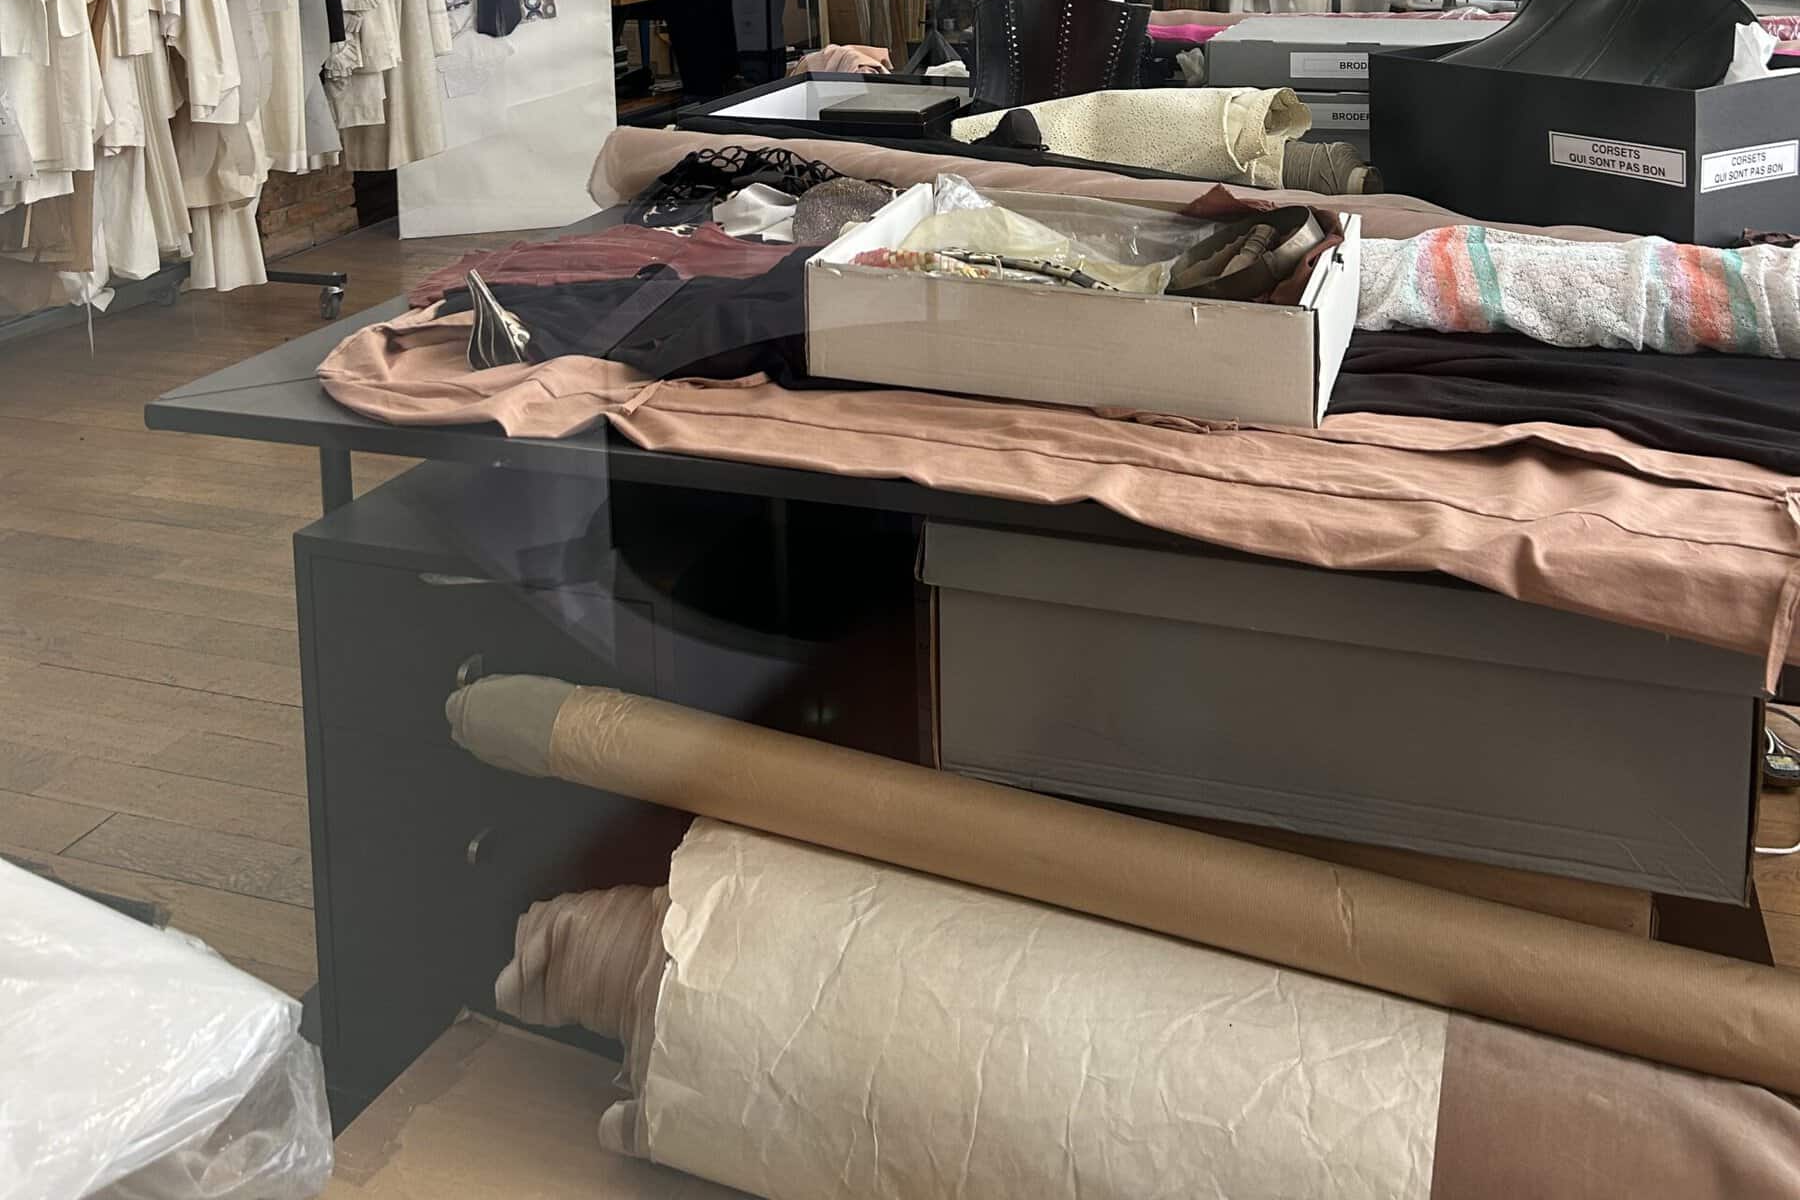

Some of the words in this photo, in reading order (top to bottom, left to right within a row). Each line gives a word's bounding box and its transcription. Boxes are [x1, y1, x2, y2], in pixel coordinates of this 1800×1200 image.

[1591, 143, 1641, 160] CORSETS
[1731, 152, 1767, 166] CORSETS
[1569, 153, 1587, 164] QUI
[1588, 155, 1616, 168] SONT
[1619, 160, 1640, 173] PAS
[1643, 164, 1666, 177] BON
[1714, 172, 1727, 184] QUI
[1728, 169, 1748, 181] SONT
[1750, 165, 1766, 177] PAS
[1767, 162, 1784, 174] BON
